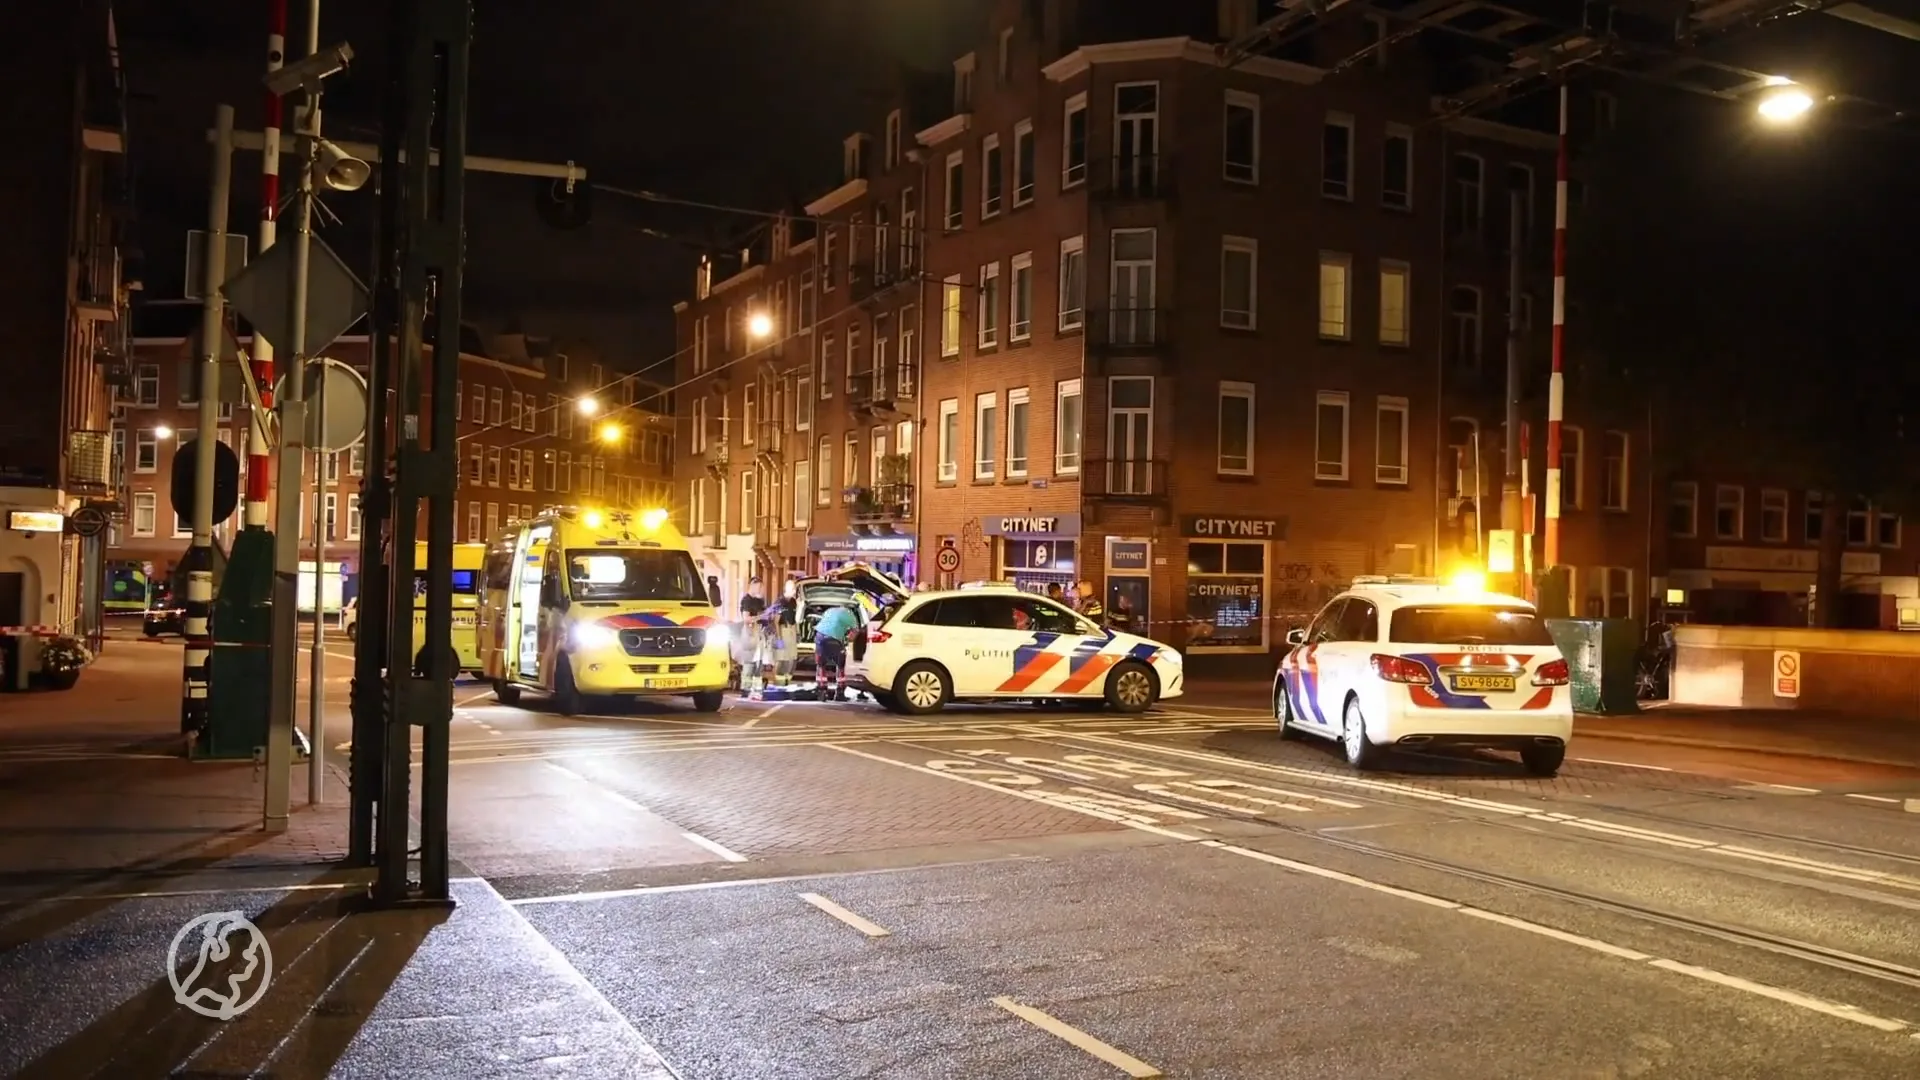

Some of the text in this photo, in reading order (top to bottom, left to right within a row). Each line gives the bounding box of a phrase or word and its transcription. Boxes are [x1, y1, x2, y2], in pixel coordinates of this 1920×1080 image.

[1001, 517, 1055, 532] CITYNET
[1195, 518, 1276, 536] CITYNET
[941, 554, 956, 565] 30
[1115, 551, 1144, 560] CITYNET
[1198, 584, 1250, 596] CITYNET
[1460, 677, 1511, 688] SV-986-Z
